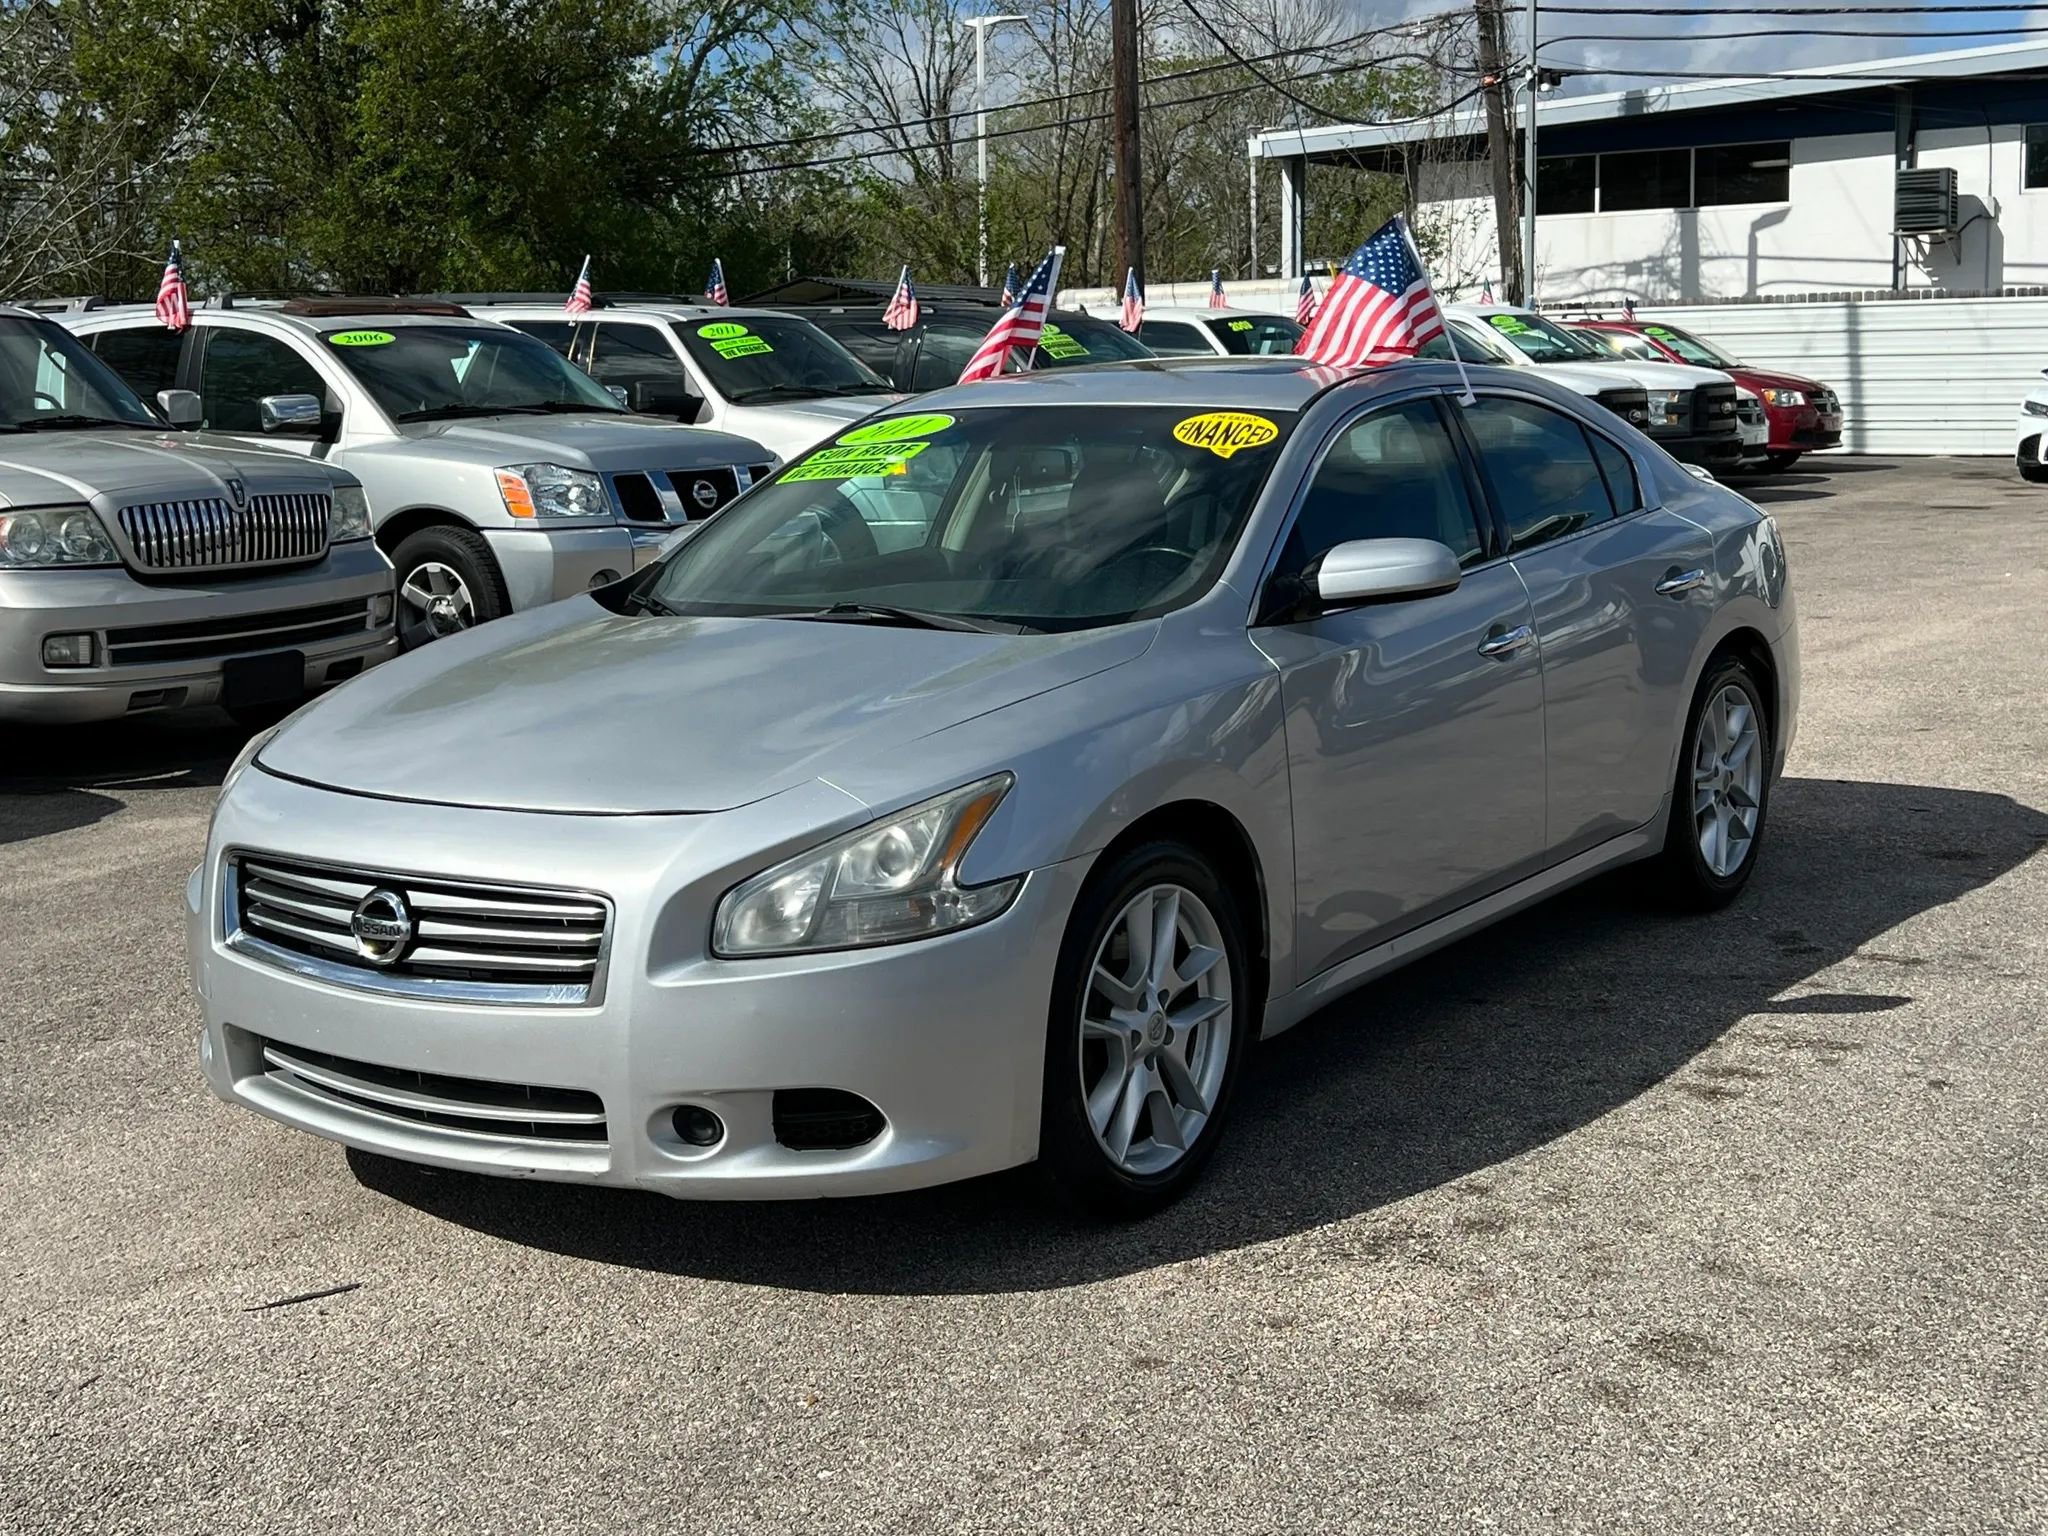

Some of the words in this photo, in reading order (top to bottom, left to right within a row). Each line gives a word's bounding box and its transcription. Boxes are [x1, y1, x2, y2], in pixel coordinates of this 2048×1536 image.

[343, 333, 383, 344] 2006
[708, 325, 736, 337] 2011
[737, 343, 768, 353] FINANCE
[850, 418, 936, 442] 2011
[1177, 420, 1273, 447] FINANCED
[813, 447, 857, 461] SUN
[856, 444, 919, 457] ROOF
[784, 465, 819, 480] WE
[809, 461, 892, 477] FINANCE
[356, 918, 402, 936] NISSAN
